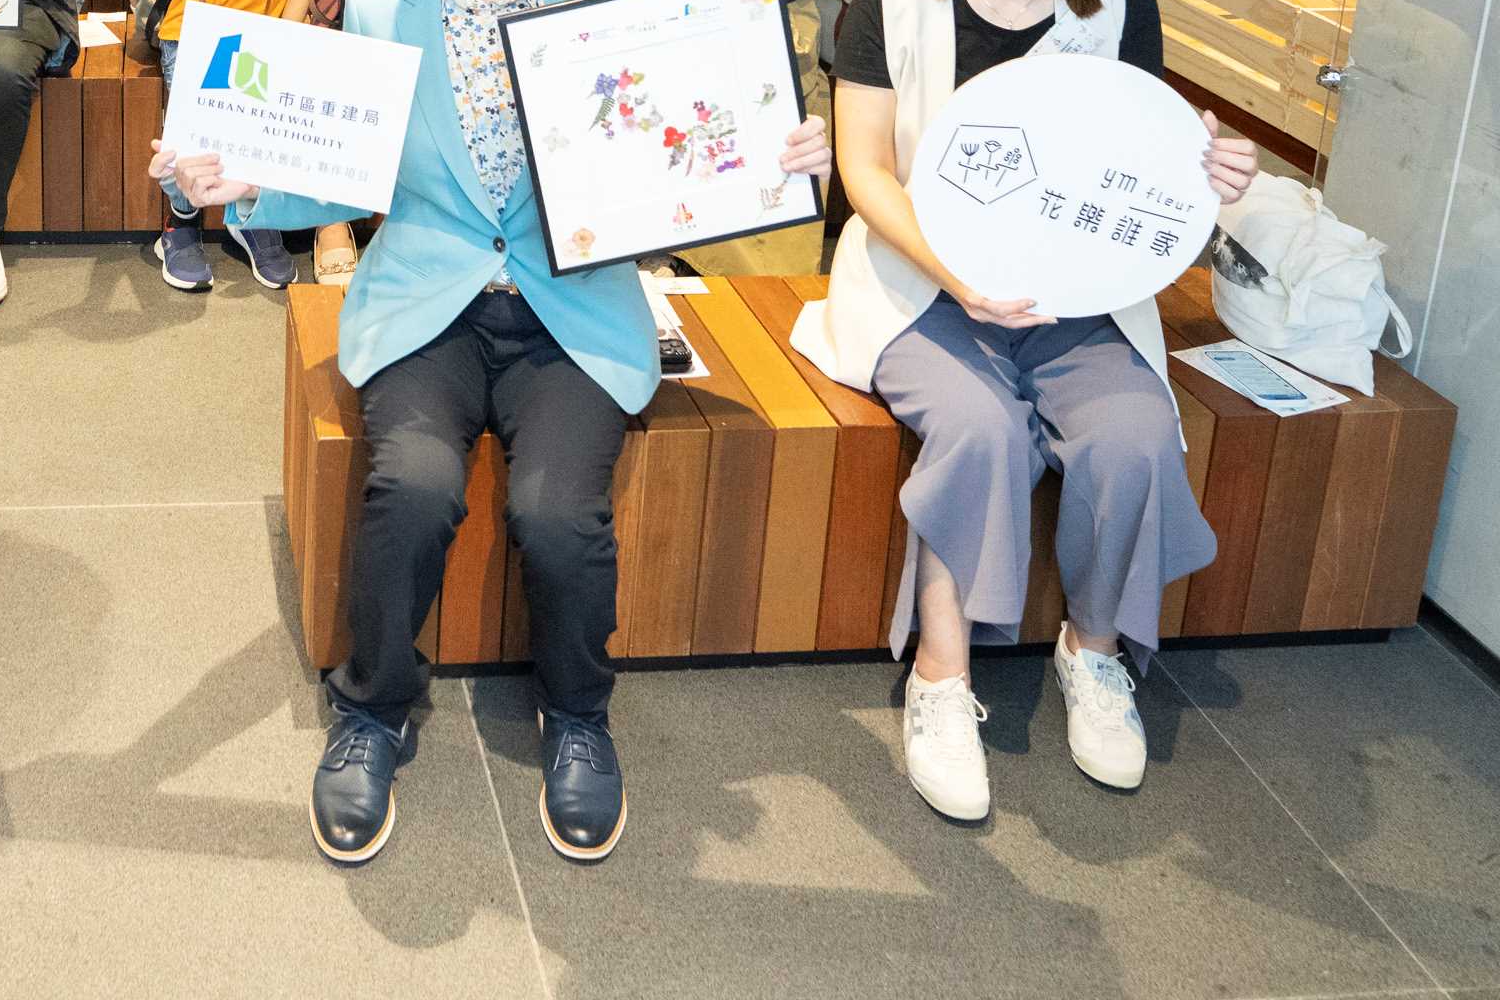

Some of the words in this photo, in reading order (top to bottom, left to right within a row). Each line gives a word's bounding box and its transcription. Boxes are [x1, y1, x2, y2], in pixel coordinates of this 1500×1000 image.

[197, 97, 245, 114] URBAN
[250, 107, 316, 129] RENEWAL
[279, 91, 380, 127] 市區重建局
[262, 126, 344, 150] AUTHORITY
[1100, 167, 1138, 193] ym
[1146, 187, 1195, 213] fleur
[1039, 187, 1180, 257] 花樂誰家
